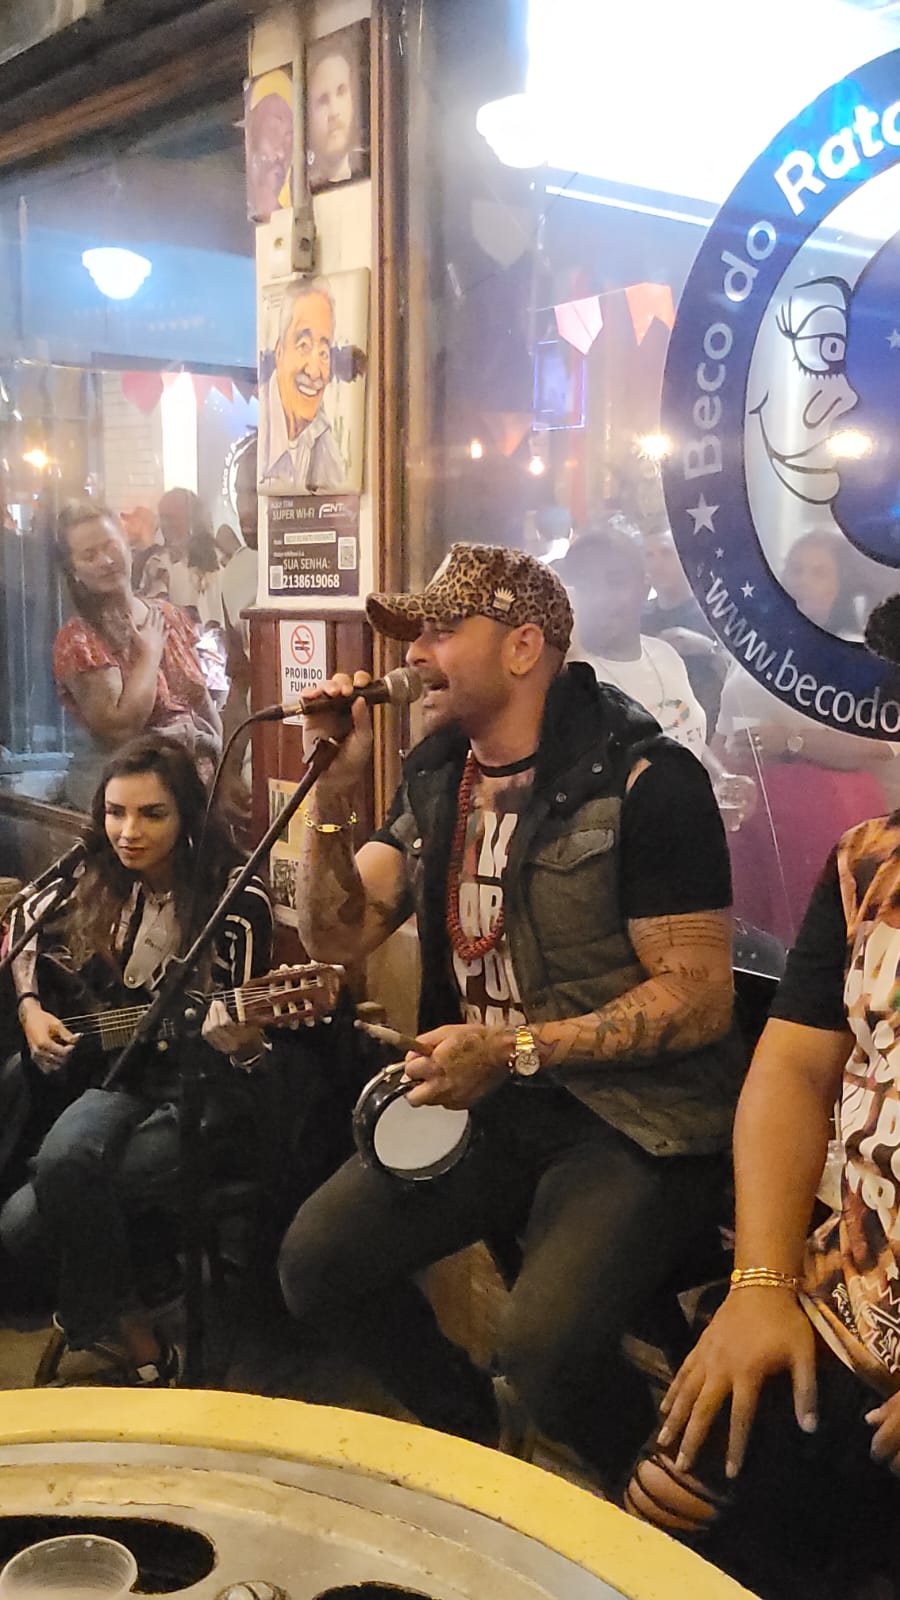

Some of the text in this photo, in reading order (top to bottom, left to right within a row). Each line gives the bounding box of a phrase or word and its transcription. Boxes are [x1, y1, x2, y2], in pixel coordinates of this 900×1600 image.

[683, 322, 734, 480] Beco
[723, 220, 777, 303] do
[272, 508, 295, 520] SUPER
[283, 557, 331, 570] SUA SENHA:
[283, 574, 340, 589] 2138619068
[285, 667, 323, 680] PROIBIDO
